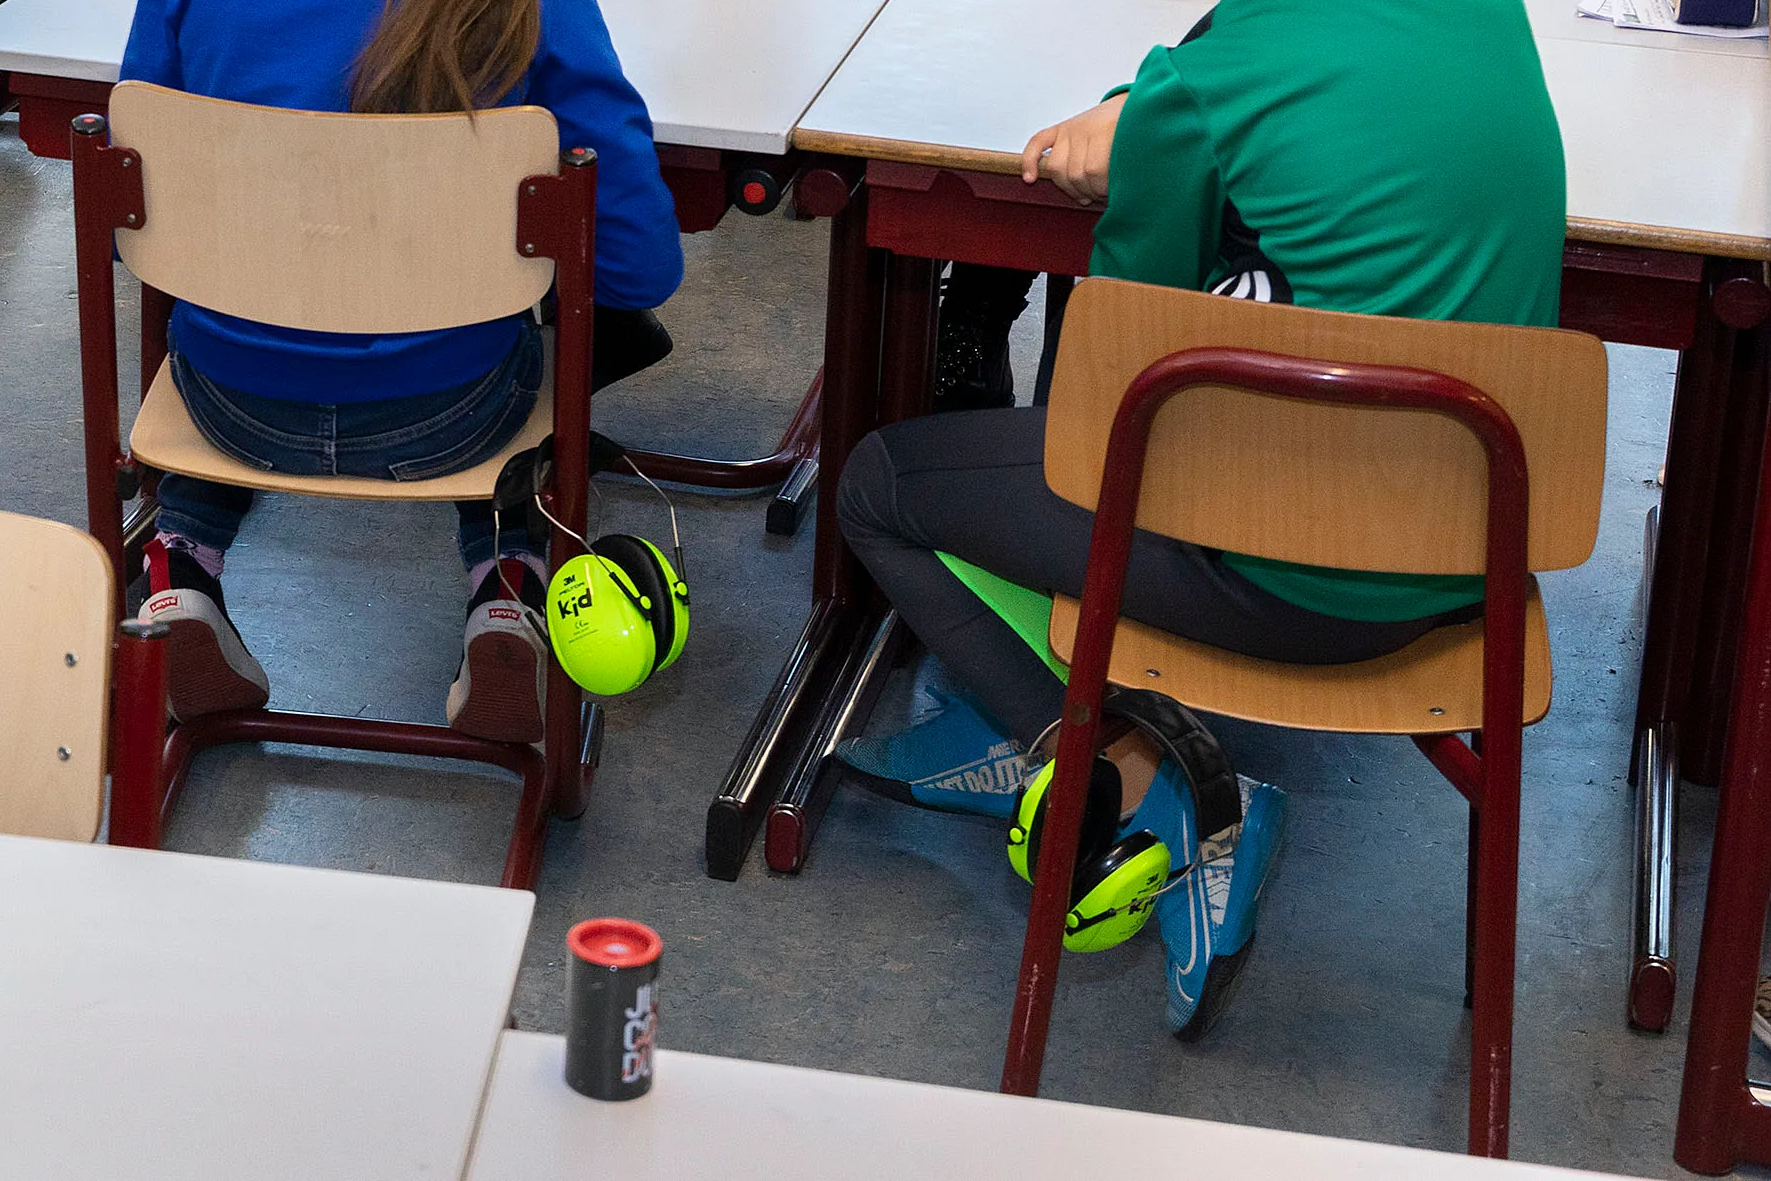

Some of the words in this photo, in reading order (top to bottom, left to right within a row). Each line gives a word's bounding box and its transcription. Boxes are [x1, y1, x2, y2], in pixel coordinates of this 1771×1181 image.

[563, 574, 576, 586] 3M
[557, 587, 593, 620] kid
[963, 765, 994, 794] DO
